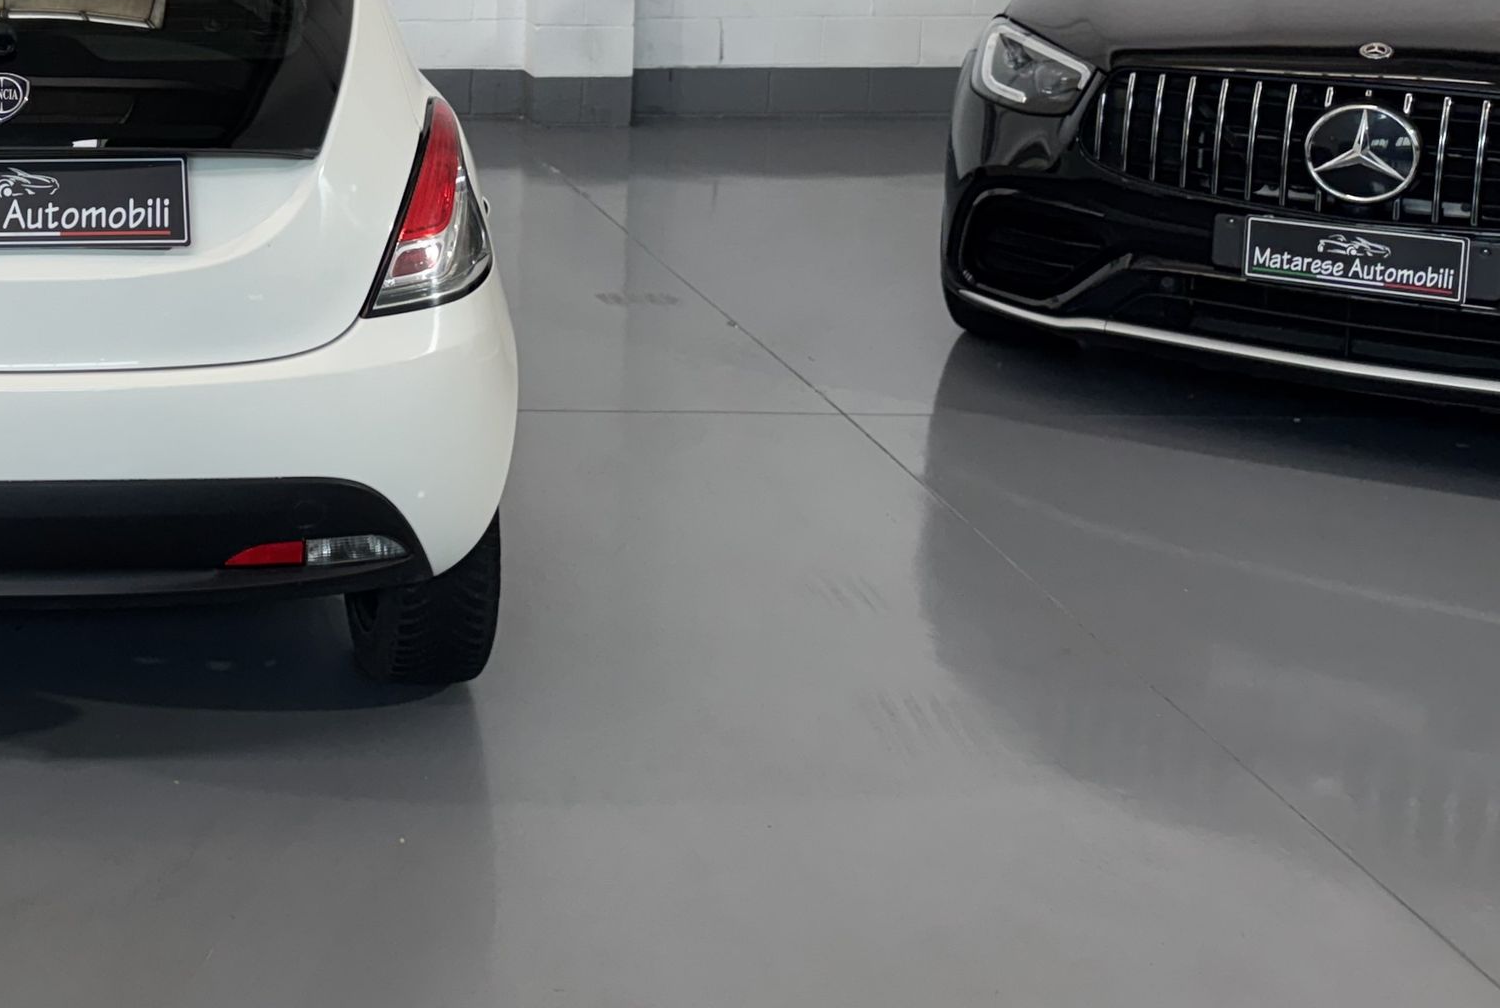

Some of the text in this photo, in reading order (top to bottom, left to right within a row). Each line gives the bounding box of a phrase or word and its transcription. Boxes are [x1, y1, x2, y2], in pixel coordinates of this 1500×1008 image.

[2, 197, 170, 230] Automobili
[1253, 246, 1455, 290] Matarese Automobili
